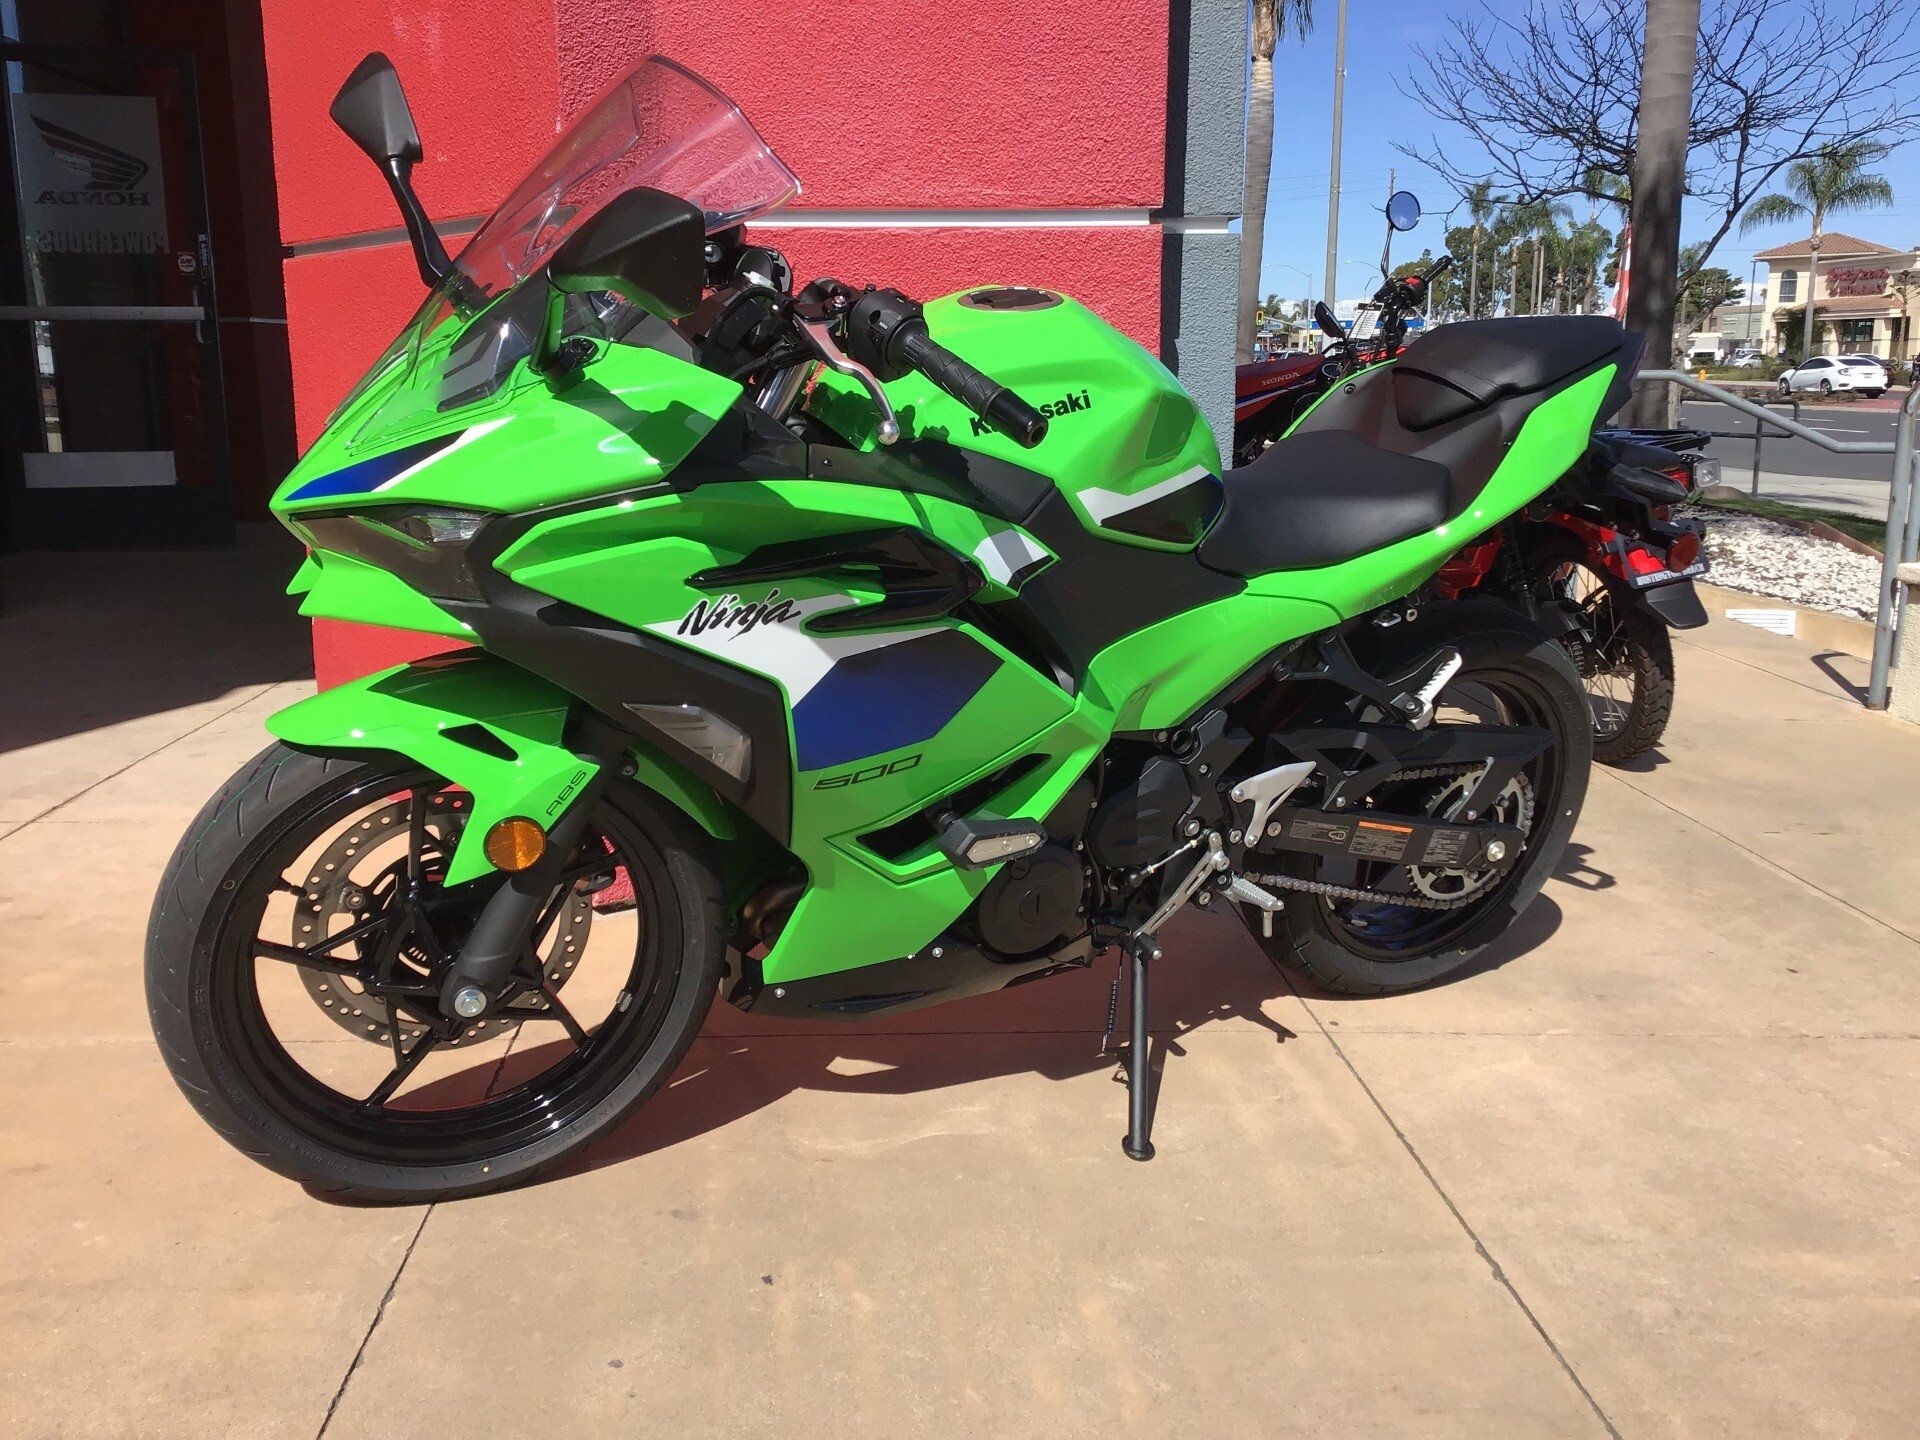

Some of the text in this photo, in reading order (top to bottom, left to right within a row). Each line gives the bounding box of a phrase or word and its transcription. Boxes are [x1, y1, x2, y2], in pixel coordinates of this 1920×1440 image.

[1261, 371, 1301, 386] HONDA
[968, 389, 1092, 437] Ksaki
[677, 587, 801, 642] Ninja
[546, 769, 587, 816] ABS
[813, 753, 923, 790] 500
